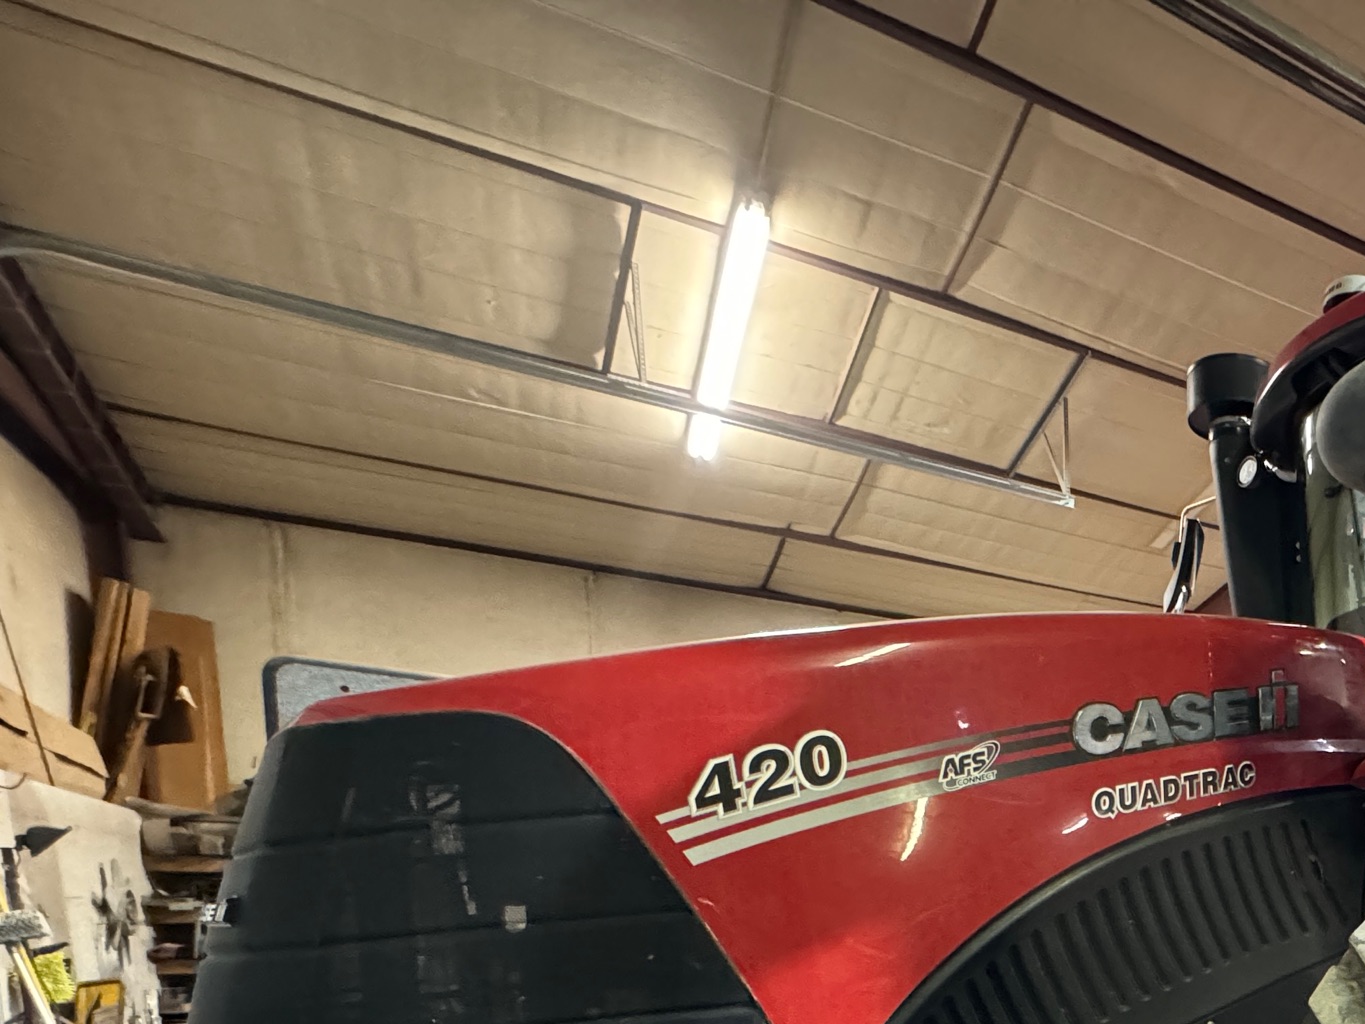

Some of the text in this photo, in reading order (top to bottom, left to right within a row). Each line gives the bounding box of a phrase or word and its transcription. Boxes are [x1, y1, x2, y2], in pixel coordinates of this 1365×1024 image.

[1073, 689, 1250, 755] CASE
[688, 730, 848, 819] 420
[940, 749, 988, 781] AFS
[957, 772, 997, 786] CONNECT
[1092, 761, 1256, 819] QUADTRAC
